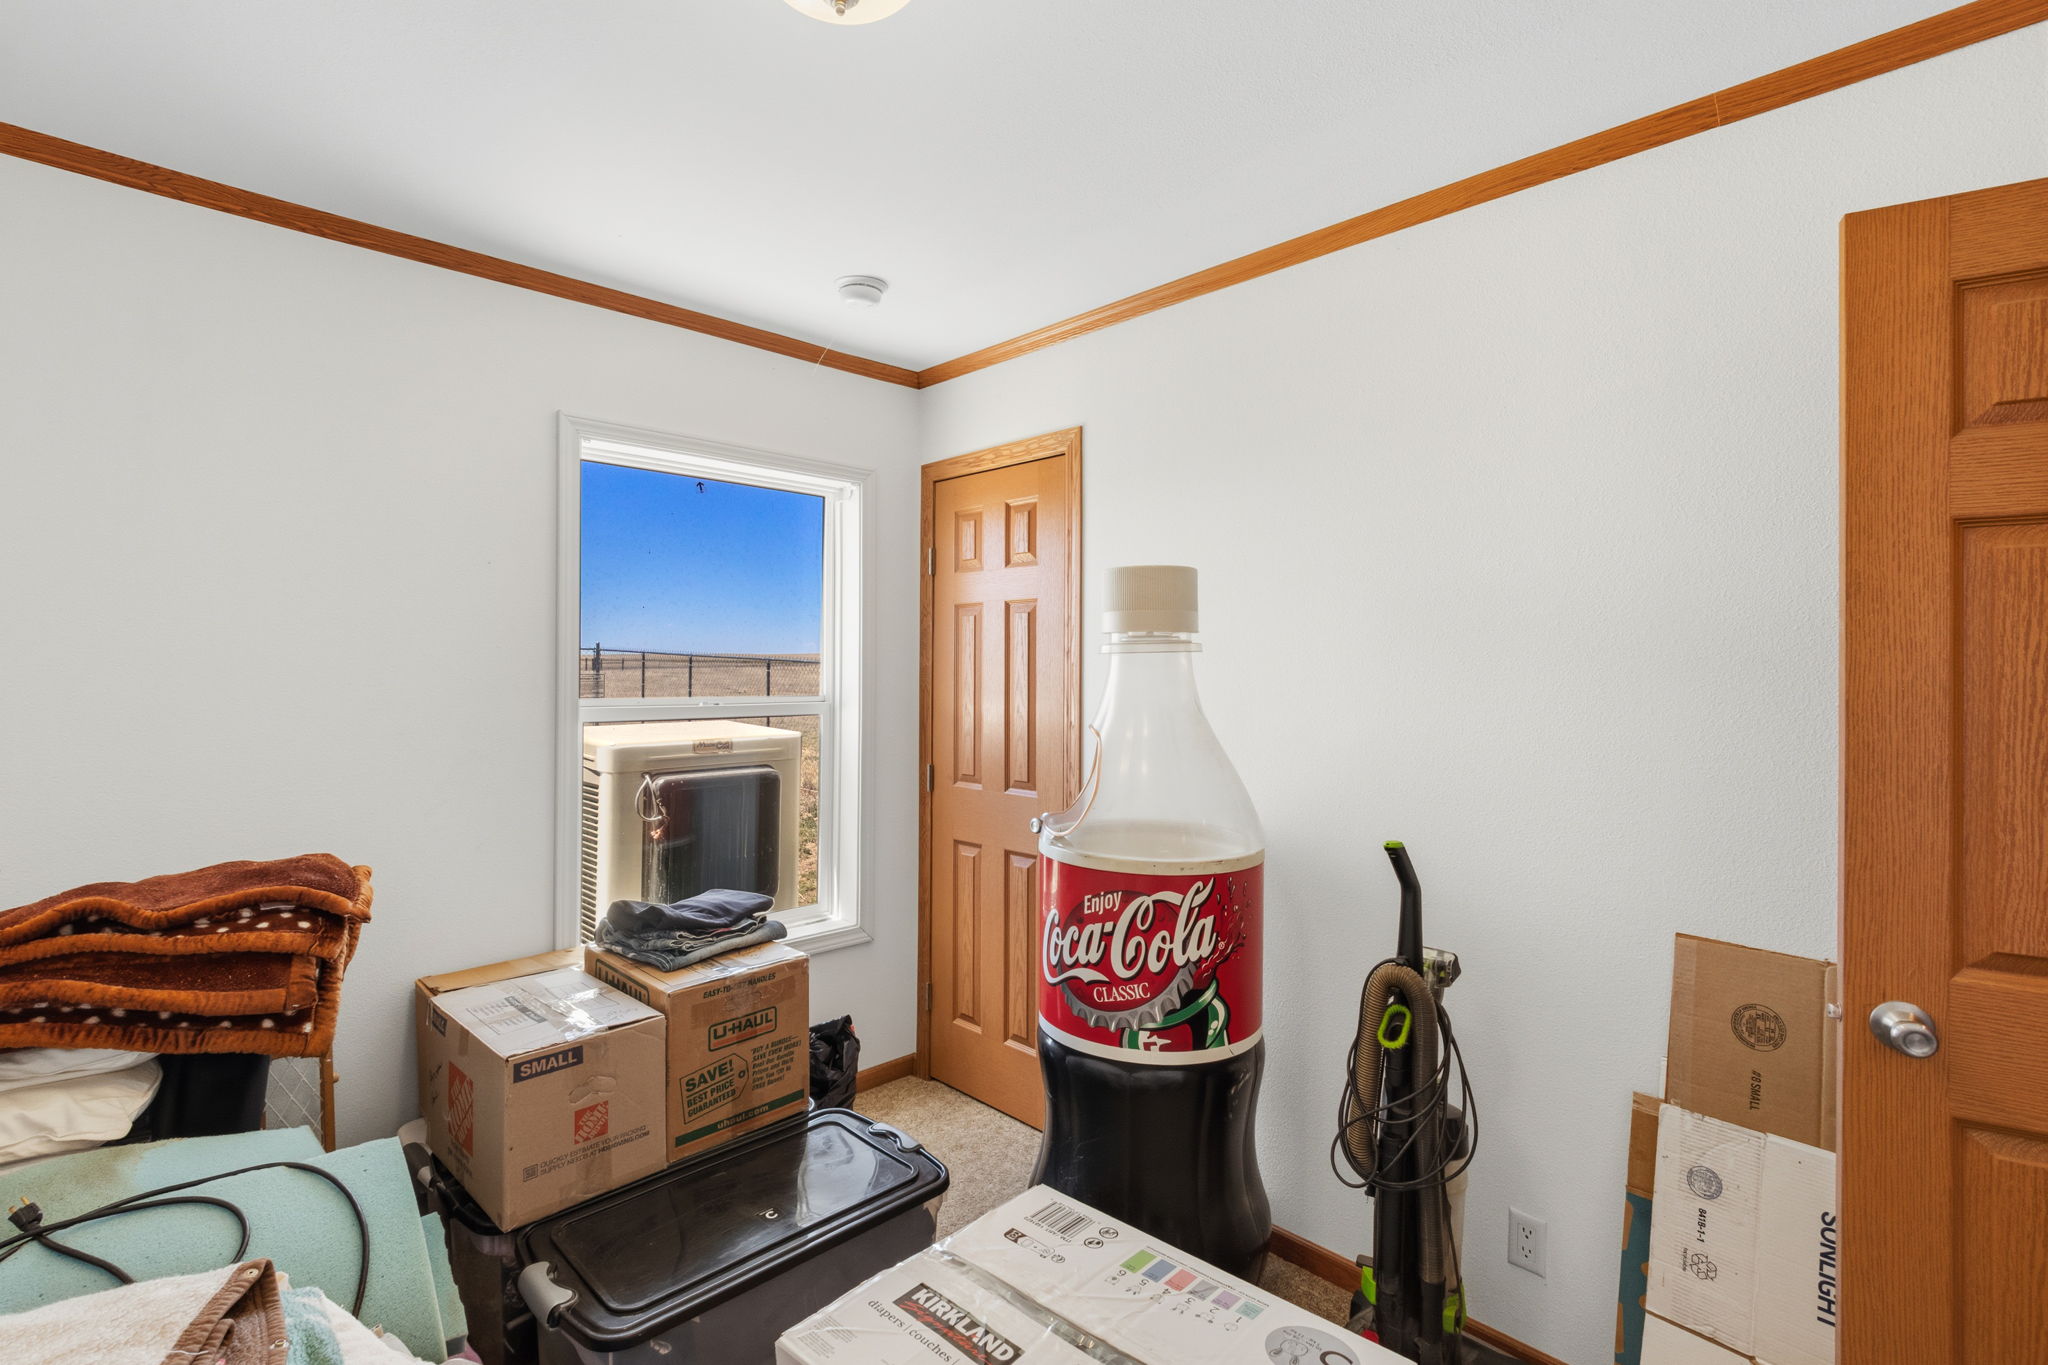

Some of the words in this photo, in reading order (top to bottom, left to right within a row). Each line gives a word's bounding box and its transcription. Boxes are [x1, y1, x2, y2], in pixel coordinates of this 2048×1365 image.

[1084, 891, 1122, 915] Enjoy
[1043, 876, 1216, 984] Coca-Cola
[1093, 982, 1150, 1003] CLASSIC
[713, 1011, 773, 1040] U-HAUL
[520, 1051, 577, 1077] SMALL
[686, 1059, 735, 1092] SAVE!
[687, 1090, 710, 1109] BEST
[711, 1079, 735, 1096] PRICE
[688, 1089, 736, 1117] GUARANTEED
[717, 1105, 769, 1129] uhaul.com
[1816, 1210, 1837, 1328] SUNLIGHT
[867, 1299, 905, 1329] diapers
[908, 1328, 953, 1363] couches
[899, 1300, 993, 1365] Signature
[911, 1287, 1015, 1361] KIRKLAND
